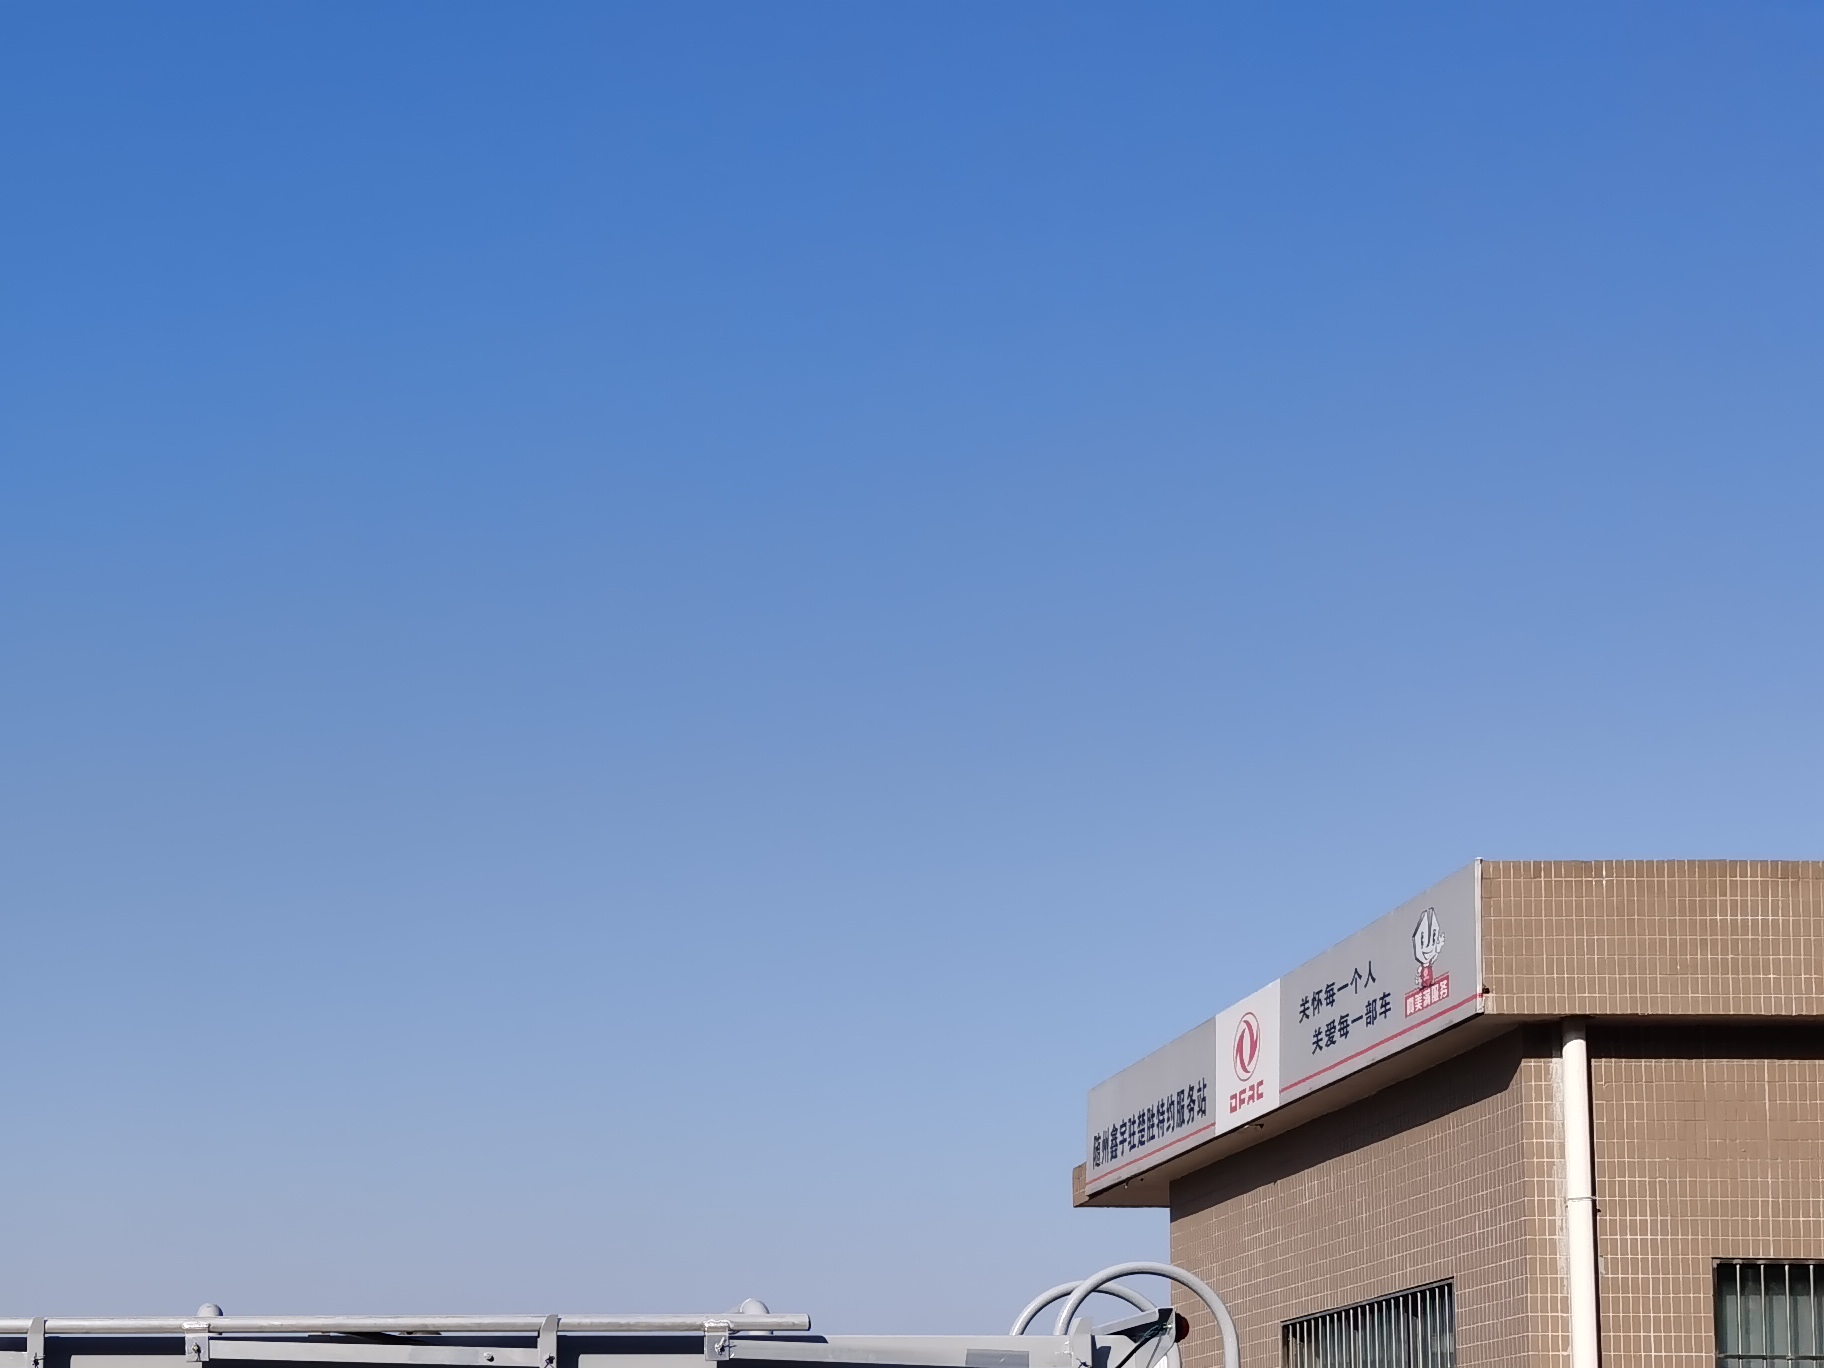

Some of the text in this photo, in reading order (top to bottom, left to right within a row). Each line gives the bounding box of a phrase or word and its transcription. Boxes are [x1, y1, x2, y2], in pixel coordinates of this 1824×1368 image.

[1299, 960, 1376, 1023] 关怀每一个人
[1312, 991, 1392, 1055] 关爱每一部车
[1092, 1077, 1207, 1170] 随州鑫宇驻楚胜特约服务站
[1230, 1080, 1264, 1114] DFAC
